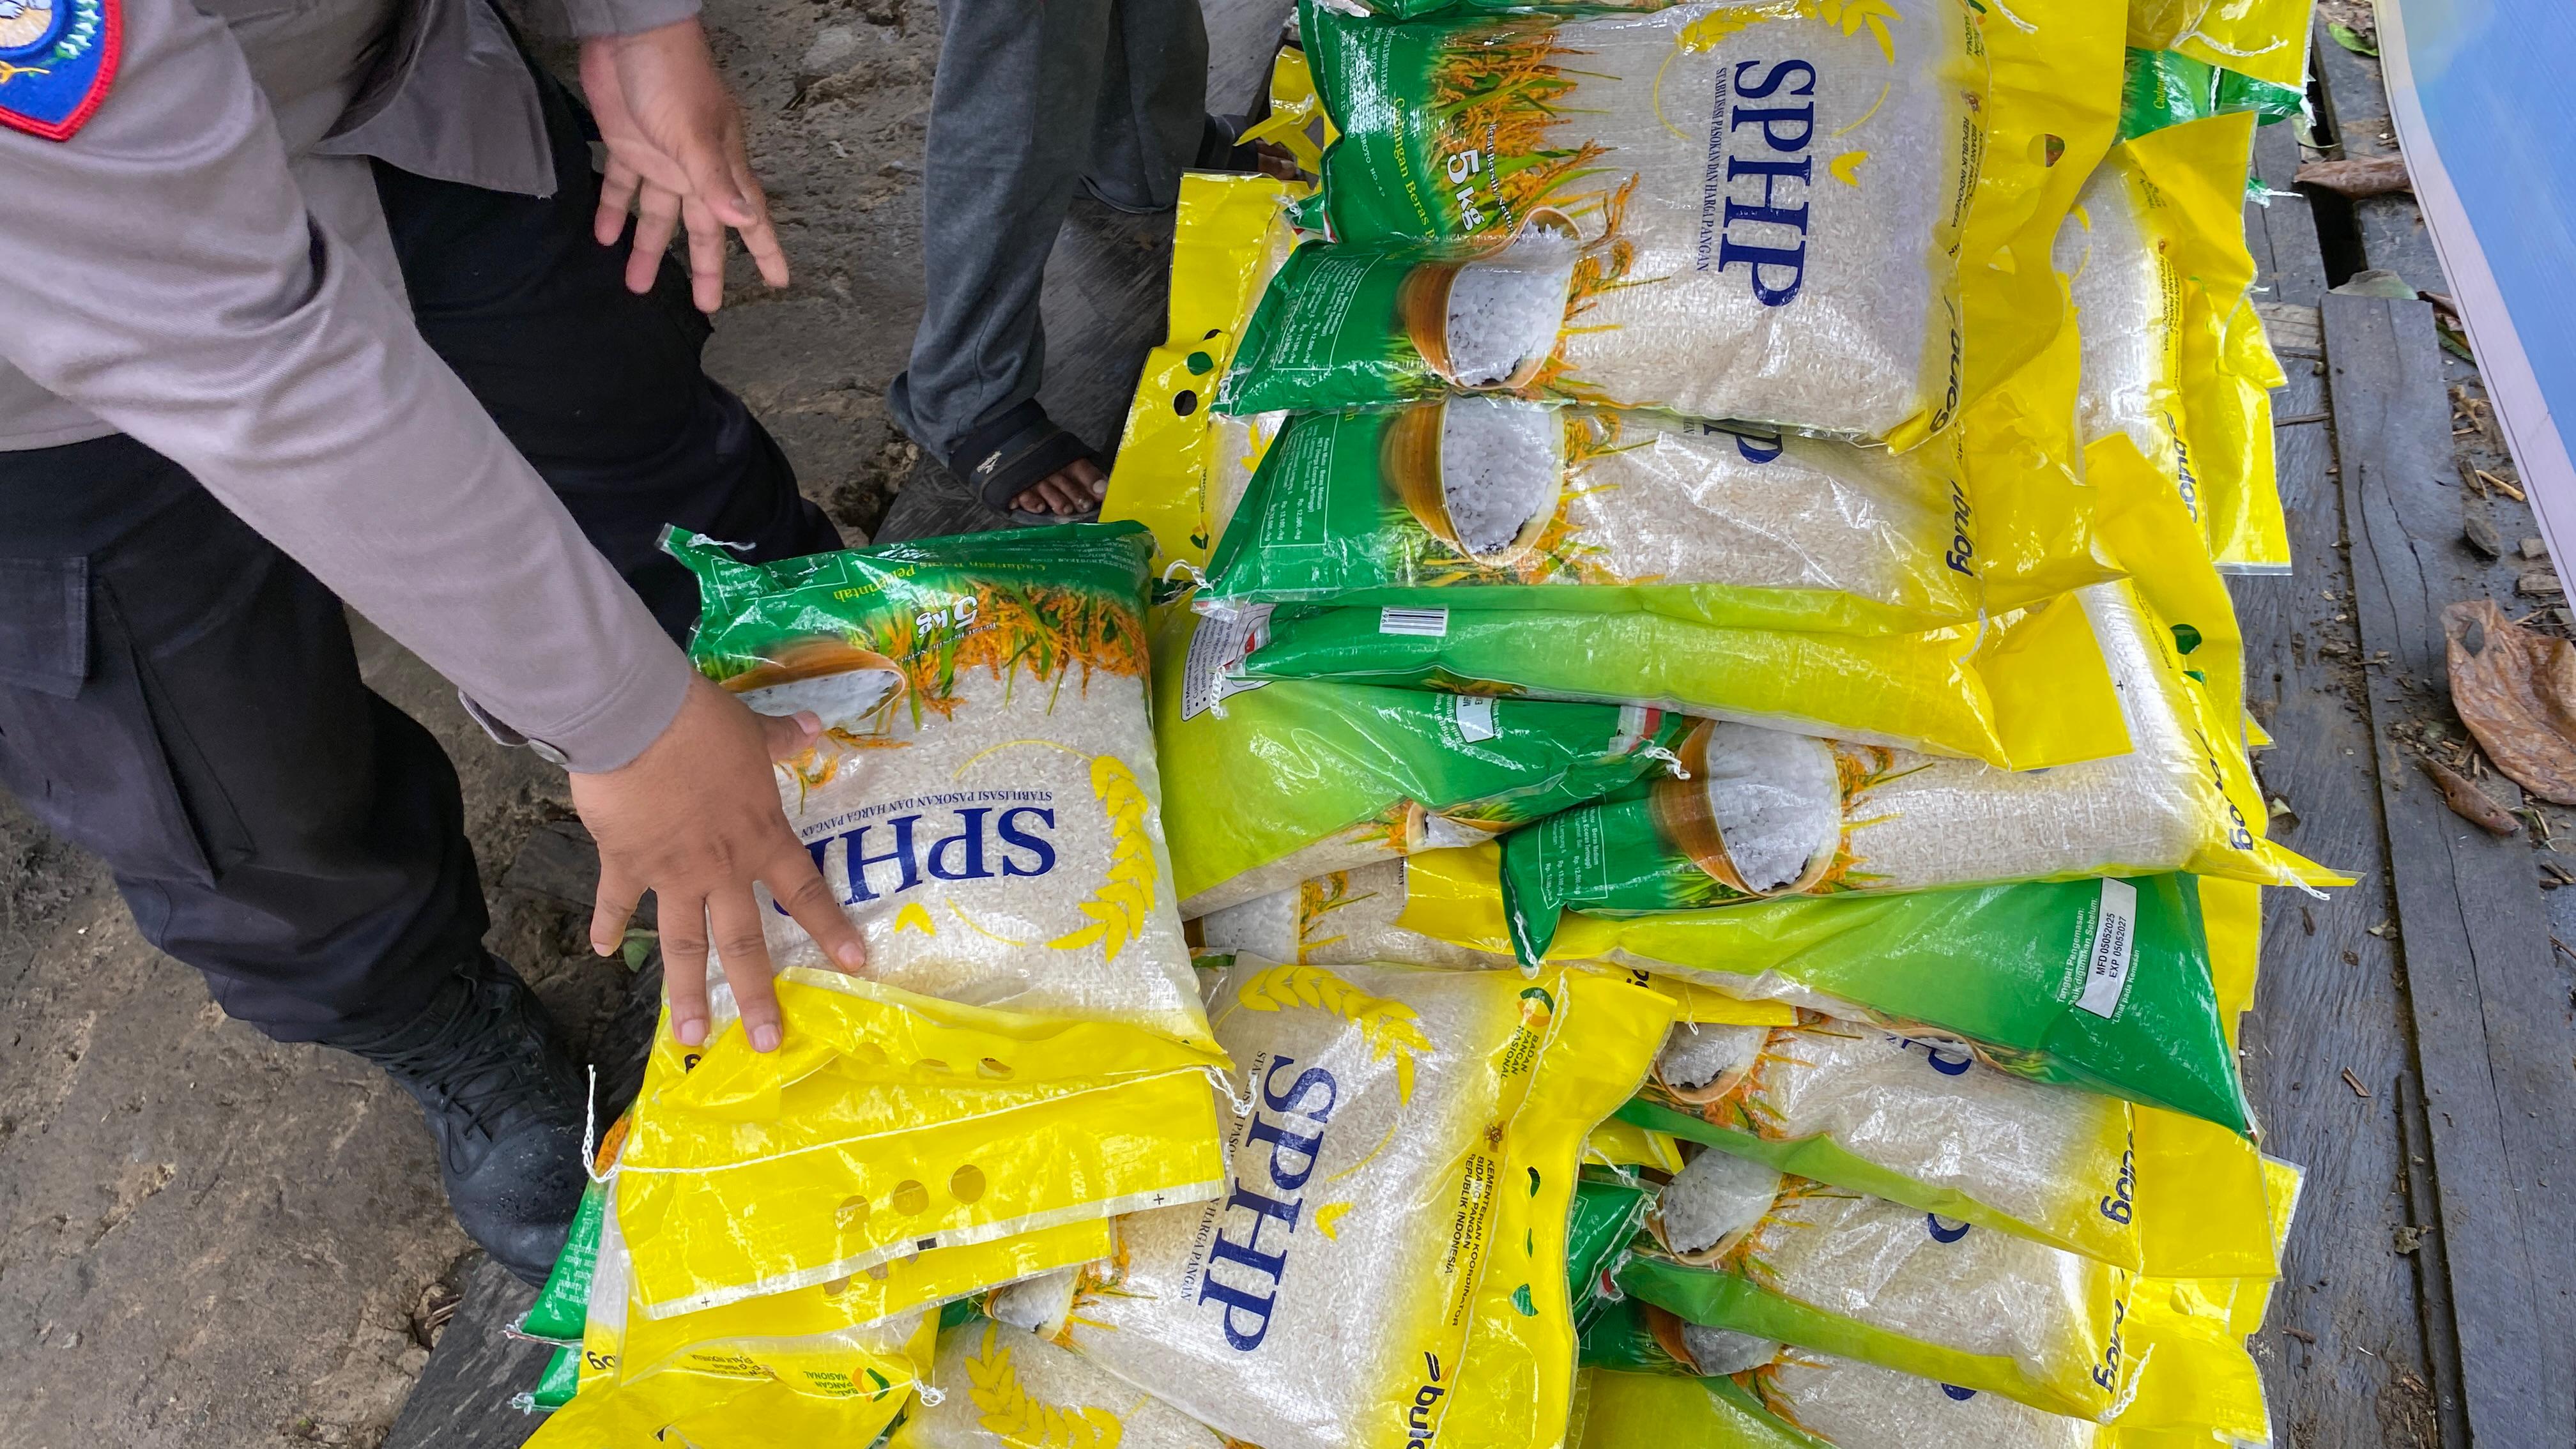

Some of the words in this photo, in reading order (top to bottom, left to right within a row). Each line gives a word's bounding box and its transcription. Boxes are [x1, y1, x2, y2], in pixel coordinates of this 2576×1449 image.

[1369, 46, 1379, 75] BULOG
[1712, 67, 1728, 119] STABILISASI
[1486, 123, 1498, 152] Berat
[1707, 121, 1724, 162] PASOKAN
[1960, 116, 1970, 161] REPUBLIK
[1970, 122, 1979, 159] BIDANG
[1446, 148, 1482, 186] 5
[1706, 164, 1719, 182] DAN
[1717, 59, 1817, 307] SPHP
[1404, 180, 1433, 227] Beras
[1455, 185, 1486, 233] kg
[1702, 183, 1718, 218] HARGA
[1951, 162, 1966, 229] INDONESIA
[1696, 220, 1713, 273] PANGAN
[1310, 466, 1321, 485] Eceran
[1317, 469, 1326, 487] Beras
[1316, 487, 1326, 510] Medium
[915, 610, 948, 639] kg
[952, 595, 978, 631] 5
[845, 802, 886, 822] HARGA
[888, 798, 914, 812] DAN
[914, 791, 975, 807] PASOKAN
[977, 790, 1053, 803] STABILISASI
[800, 812, 845, 839] PANGAN
[2073, 937, 2093, 985] digunakan
[2084, 896, 2099, 936] Sebelum:
[2099, 912, 2116, 954] 05052025
[2113, 916, 2128, 956] 05052027
[2056, 967, 2075, 1004] Tanggal
[2066, 905, 2086, 967] Pengemasan:
[2095, 954, 2108, 976] MFD
[2108, 959, 2120, 978] EXP
[2121, 983, 2133, 1004] pada
[2127, 949, 2141, 983] Kemasan
[1500, 1025, 1526, 1080] NASIONAL
[1510, 1030, 1533, 1075] PANGAN
[1521, 1034, 1539, 1073] BADAN
[1459, 1153, 1477, 1208] REPUBLIK
[1471, 1155, 1485, 1200] BIDANG
[1197, 1054, 1337, 1353] SPHP
[1473, 1159, 1496, 1241] KEMENTERIAN
[1193, 1207, 1217, 1250] HARGA
[1444, 1210, 1467, 1275] INDONESIA
[1462, 1202, 1480, 1250] PANGAN
[1180, 1250, 1203, 1303] PANGAN
[1452, 1243, 1481, 1327] KOORDINATOR
[802, 1370, 848, 1381] NASIONAL
[814, 1381, 855, 1391] PANGAN
